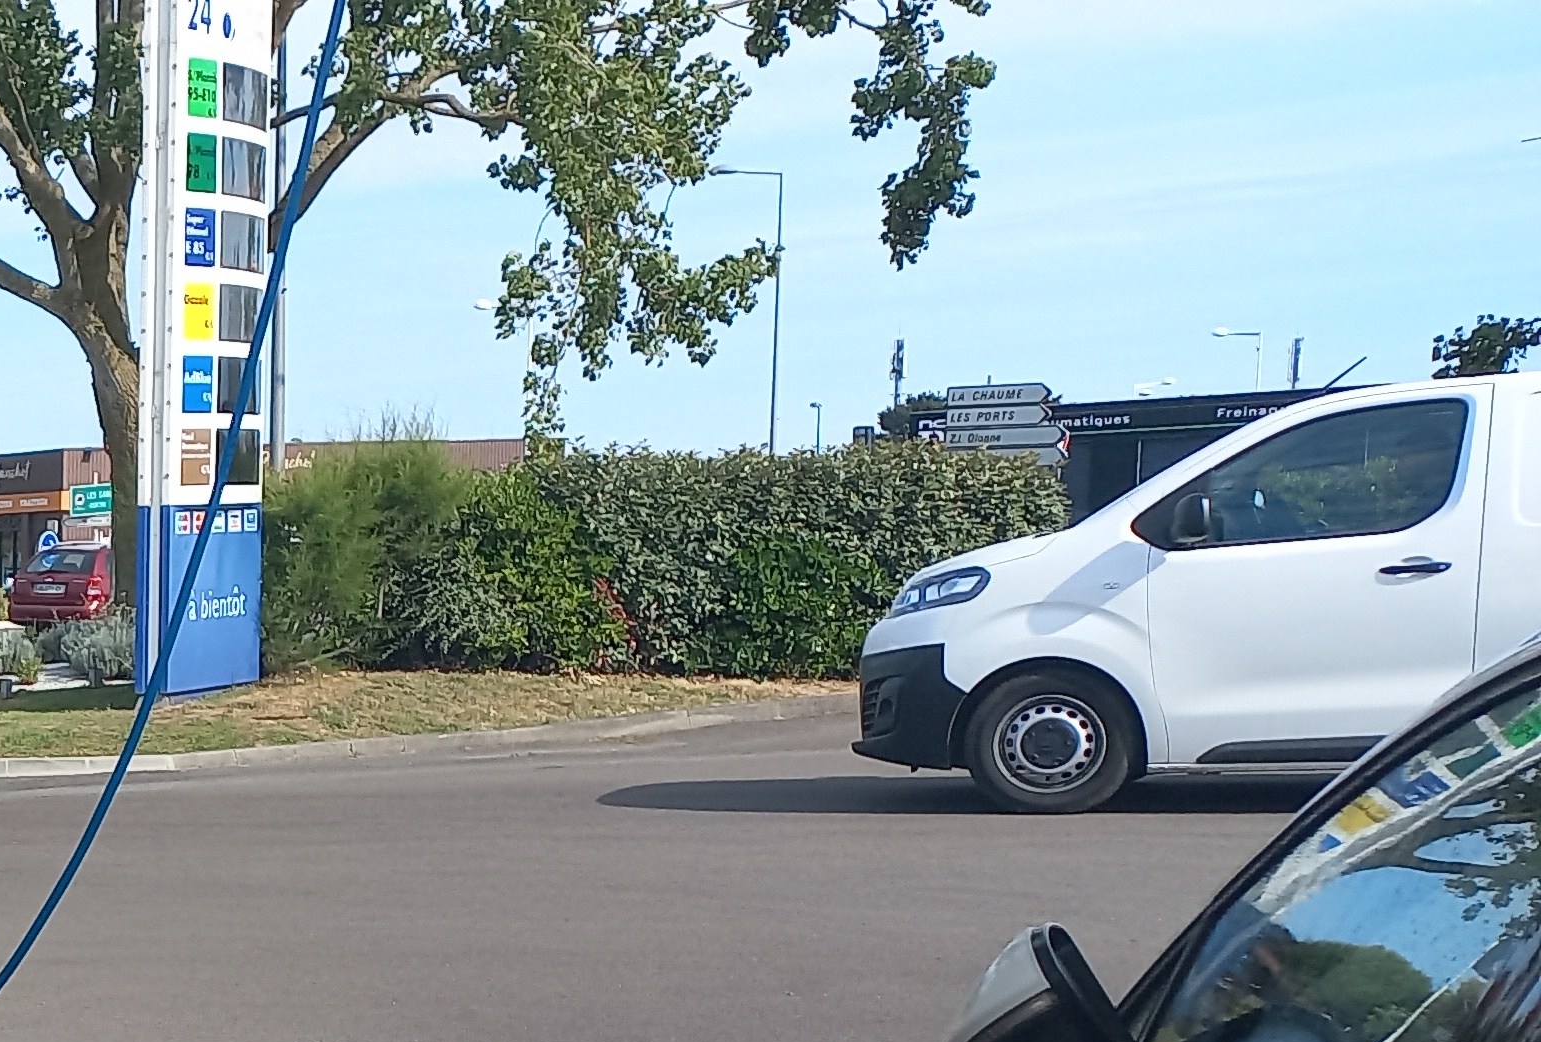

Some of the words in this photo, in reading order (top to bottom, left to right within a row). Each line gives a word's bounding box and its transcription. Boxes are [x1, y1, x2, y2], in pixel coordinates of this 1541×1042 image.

[951, 391, 965, 403] LA
[972, 388, 1024, 401] CHAUME
[950, 413, 971, 423] LES
[976, 410, 1016, 422] PORTS
[188, 588, 197, 621] à
[200, 585, 246, 620] bientôt
